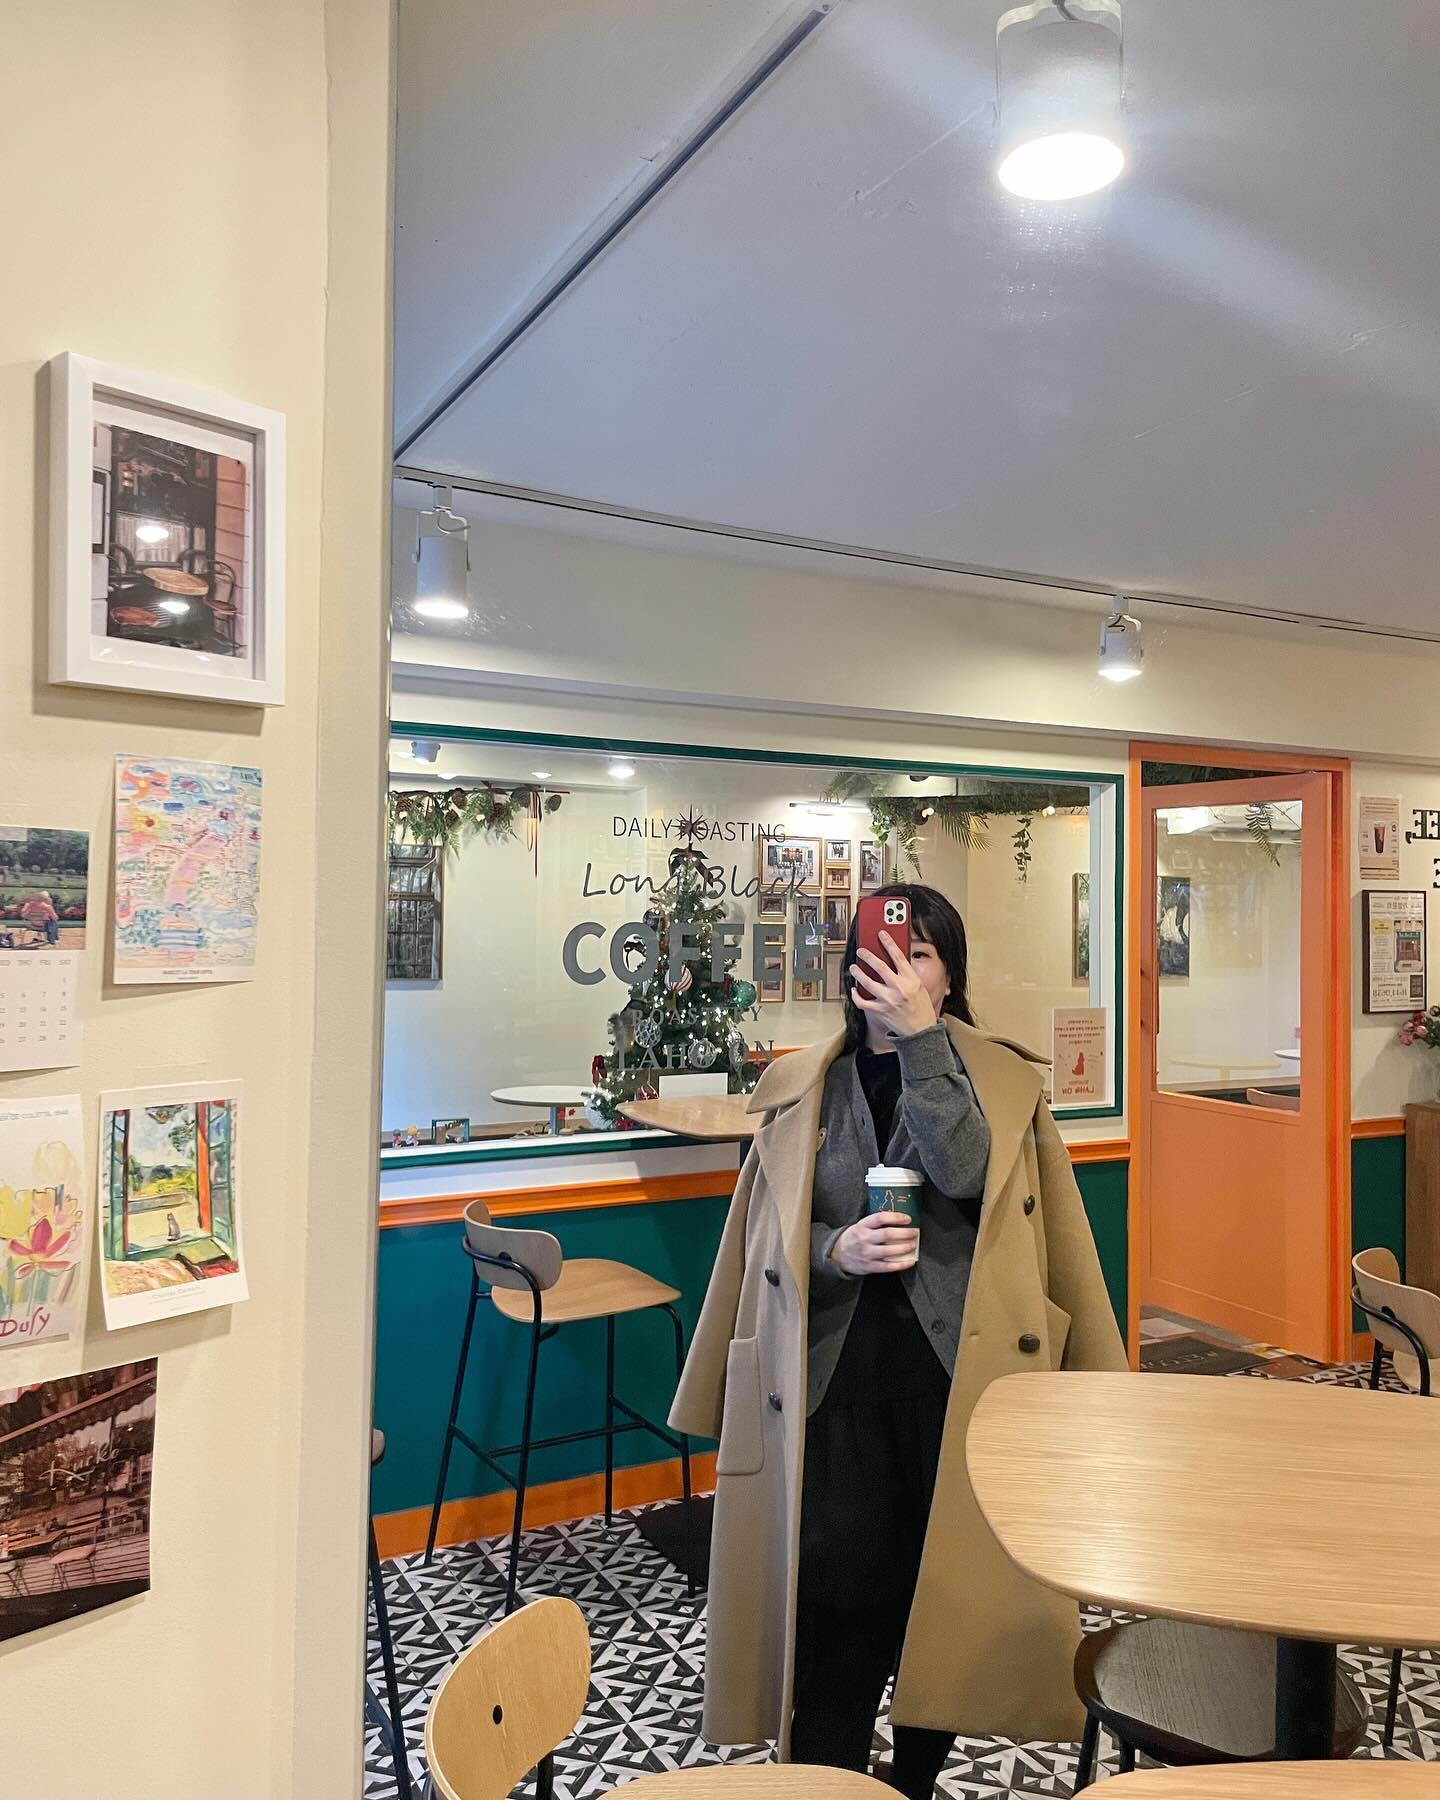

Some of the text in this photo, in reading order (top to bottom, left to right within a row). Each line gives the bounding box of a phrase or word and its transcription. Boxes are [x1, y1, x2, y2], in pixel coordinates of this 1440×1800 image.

[613, 816, 673, 839] DAILY
[703, 865, 810, 899] Black
[562, 921, 827, 985] COFFEE
